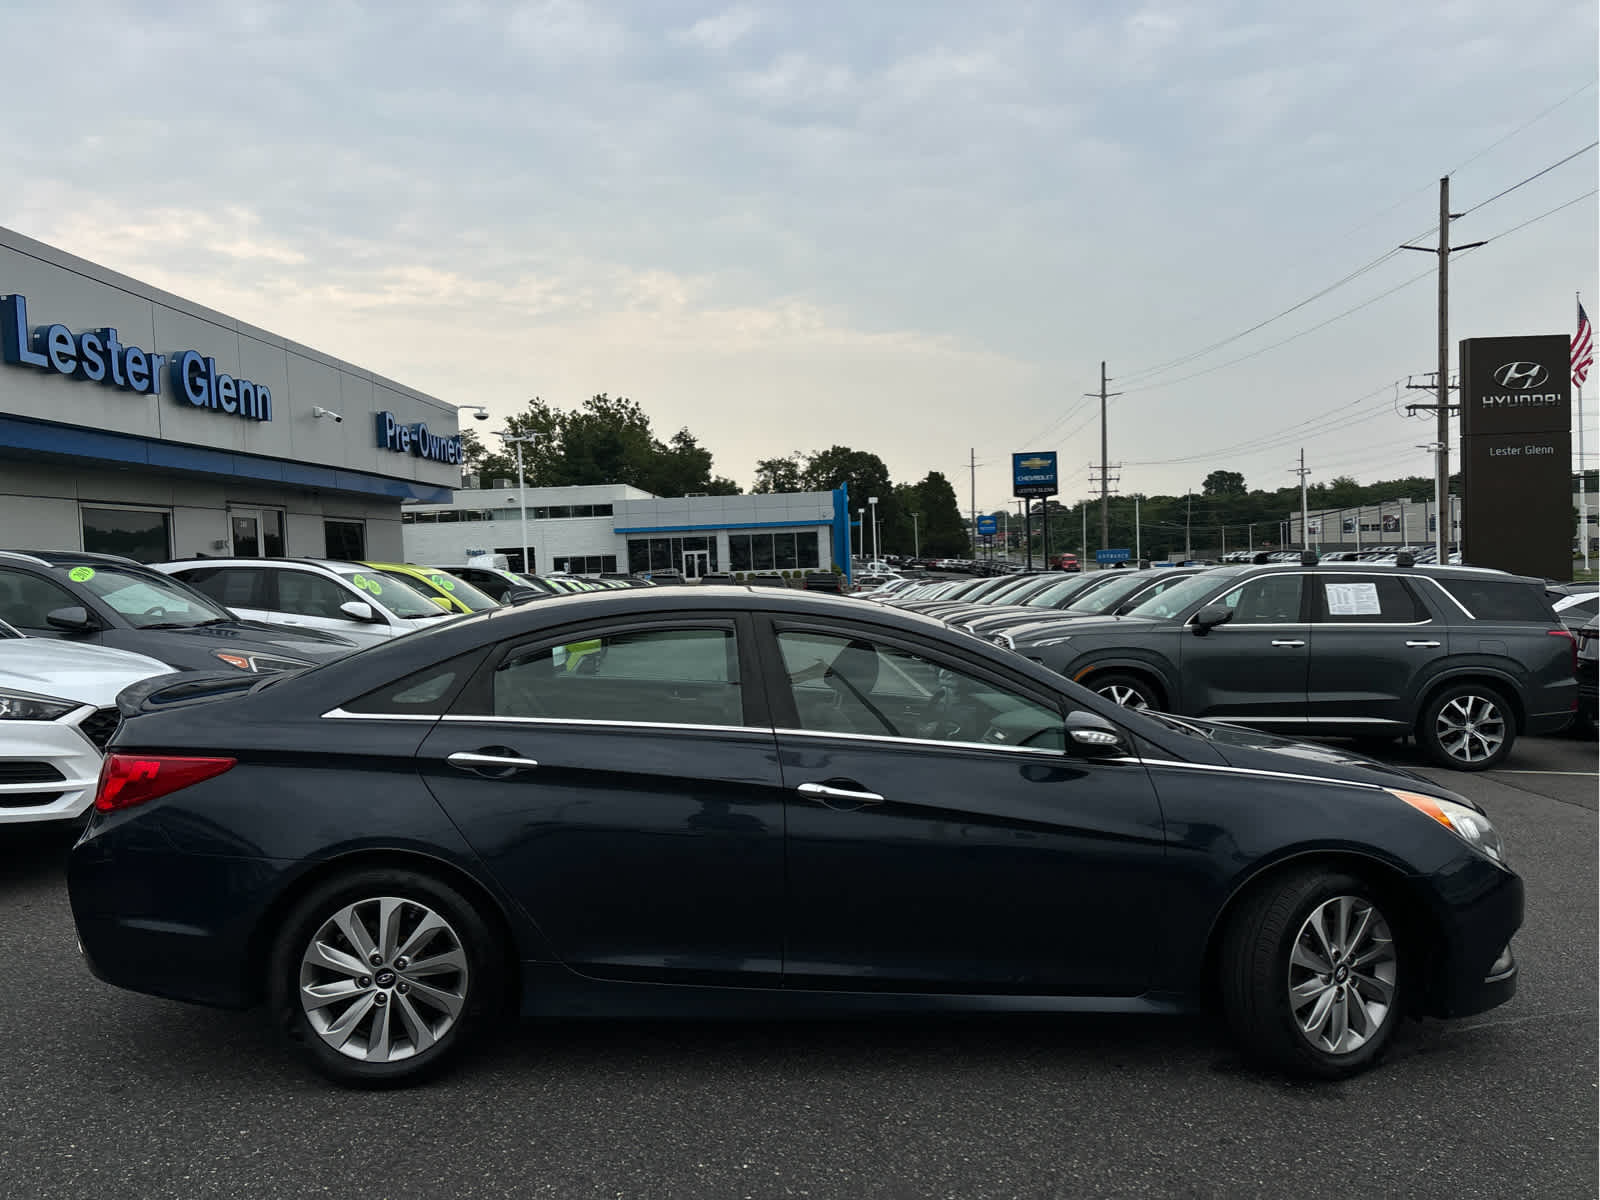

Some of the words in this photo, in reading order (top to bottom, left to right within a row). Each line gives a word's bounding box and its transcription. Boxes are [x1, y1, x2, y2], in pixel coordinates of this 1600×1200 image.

[2, 294, 166, 395] Lester
[173, 350, 272, 421] Glenn
[1482, 393, 1561, 408] HYUNDAI
[377, 411, 463, 464] Pre-Owned
[1489, 447, 1521, 456] Lester
[1525, 445, 1554, 455] Glenn
